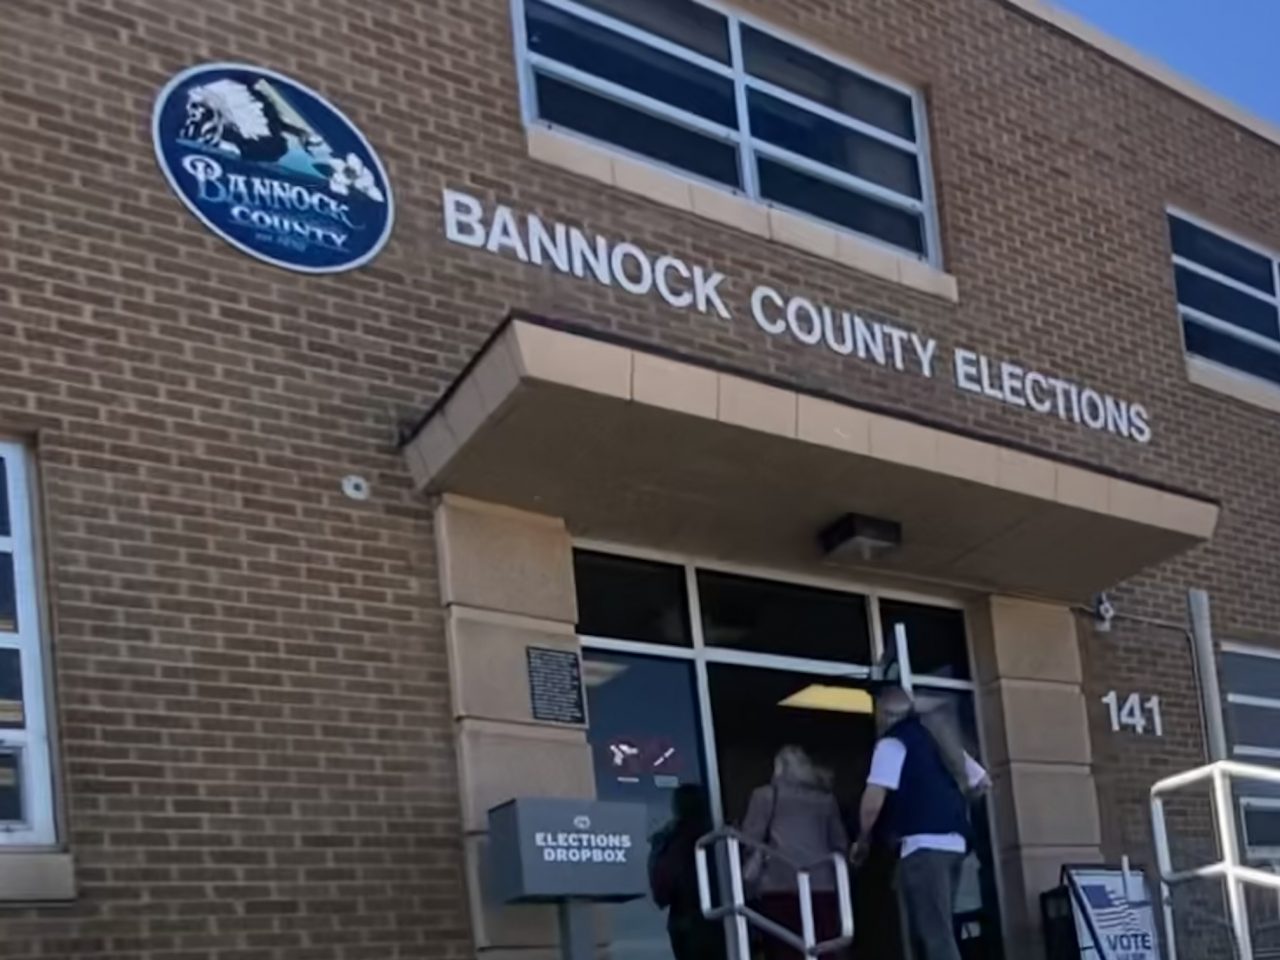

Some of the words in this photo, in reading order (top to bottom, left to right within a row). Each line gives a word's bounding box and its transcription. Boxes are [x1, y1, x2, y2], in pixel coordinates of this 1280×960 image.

[182, 154, 358, 229] BANNOCK
[230, 205, 348, 248] COUNTY
[442, 188, 731, 318] BANNOCK
[751, 284, 936, 378] COUNTY
[954, 349, 1152, 443] ELECTIONS
[1102, 690, 1163, 737] 141
[535, 832, 632, 849] ELECTIONS
[543, 848, 627, 863] DROPBOX
[1106, 932, 1151, 951] VOTE
